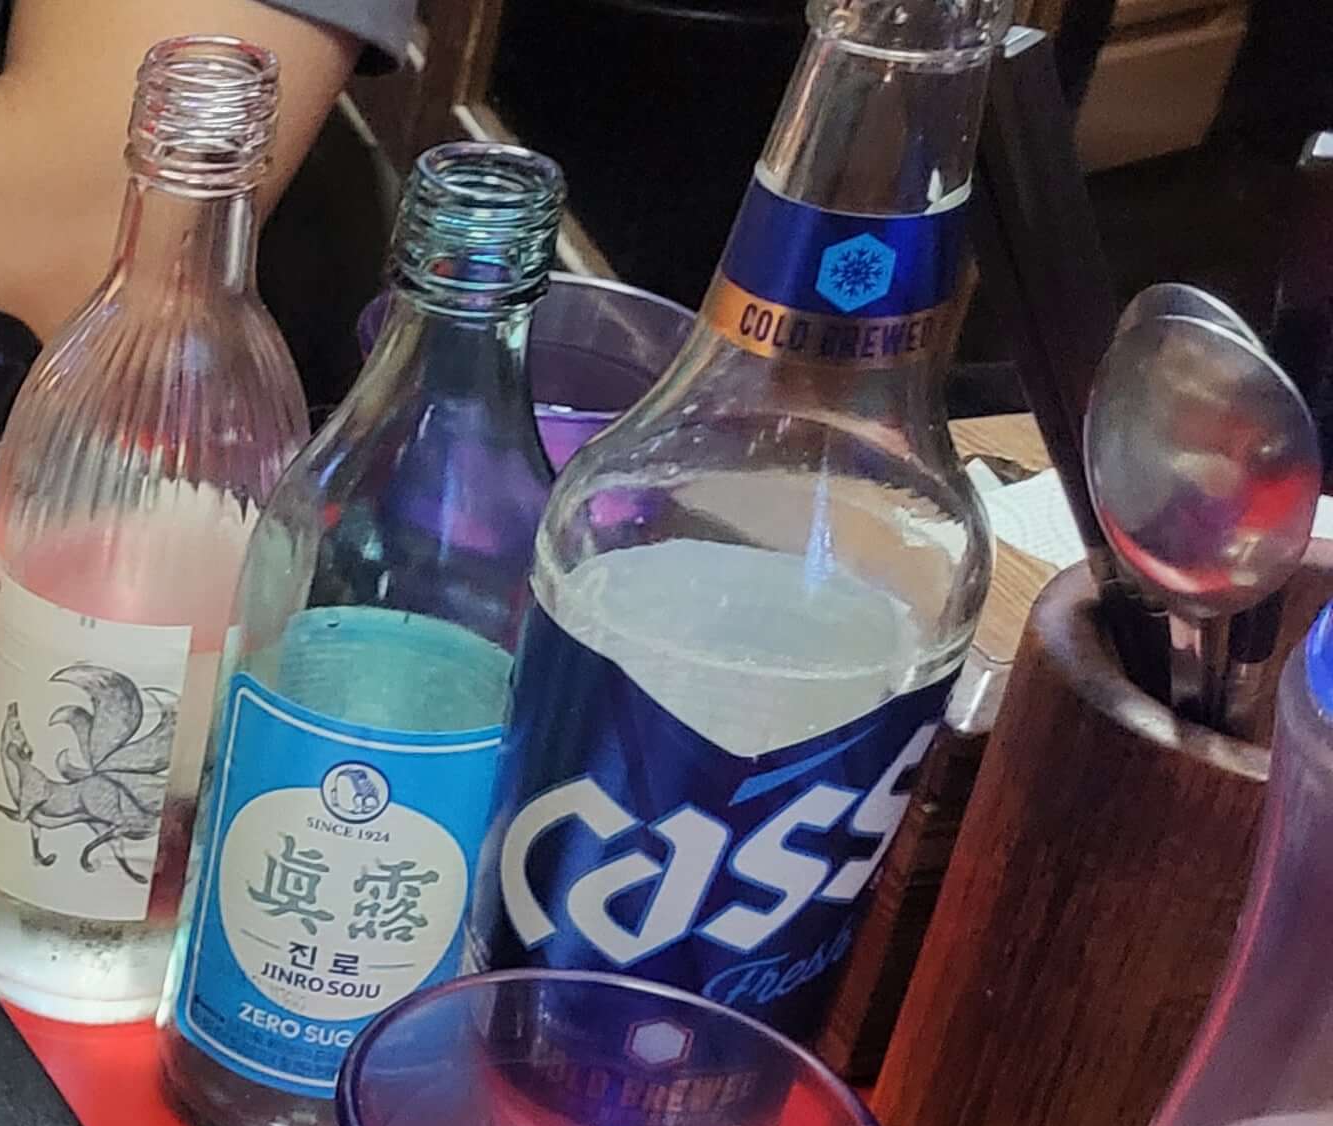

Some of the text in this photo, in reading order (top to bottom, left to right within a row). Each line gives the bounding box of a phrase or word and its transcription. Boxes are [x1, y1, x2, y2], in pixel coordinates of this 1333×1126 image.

[739, 303, 810, 350] COLD
[306, 816, 391, 843] SINCE 1924
[260, 962, 381, 999] JINRO SOJU
[238, 1002, 301, 1039] ZERO
[303, 1024, 356, 1048] SUG
